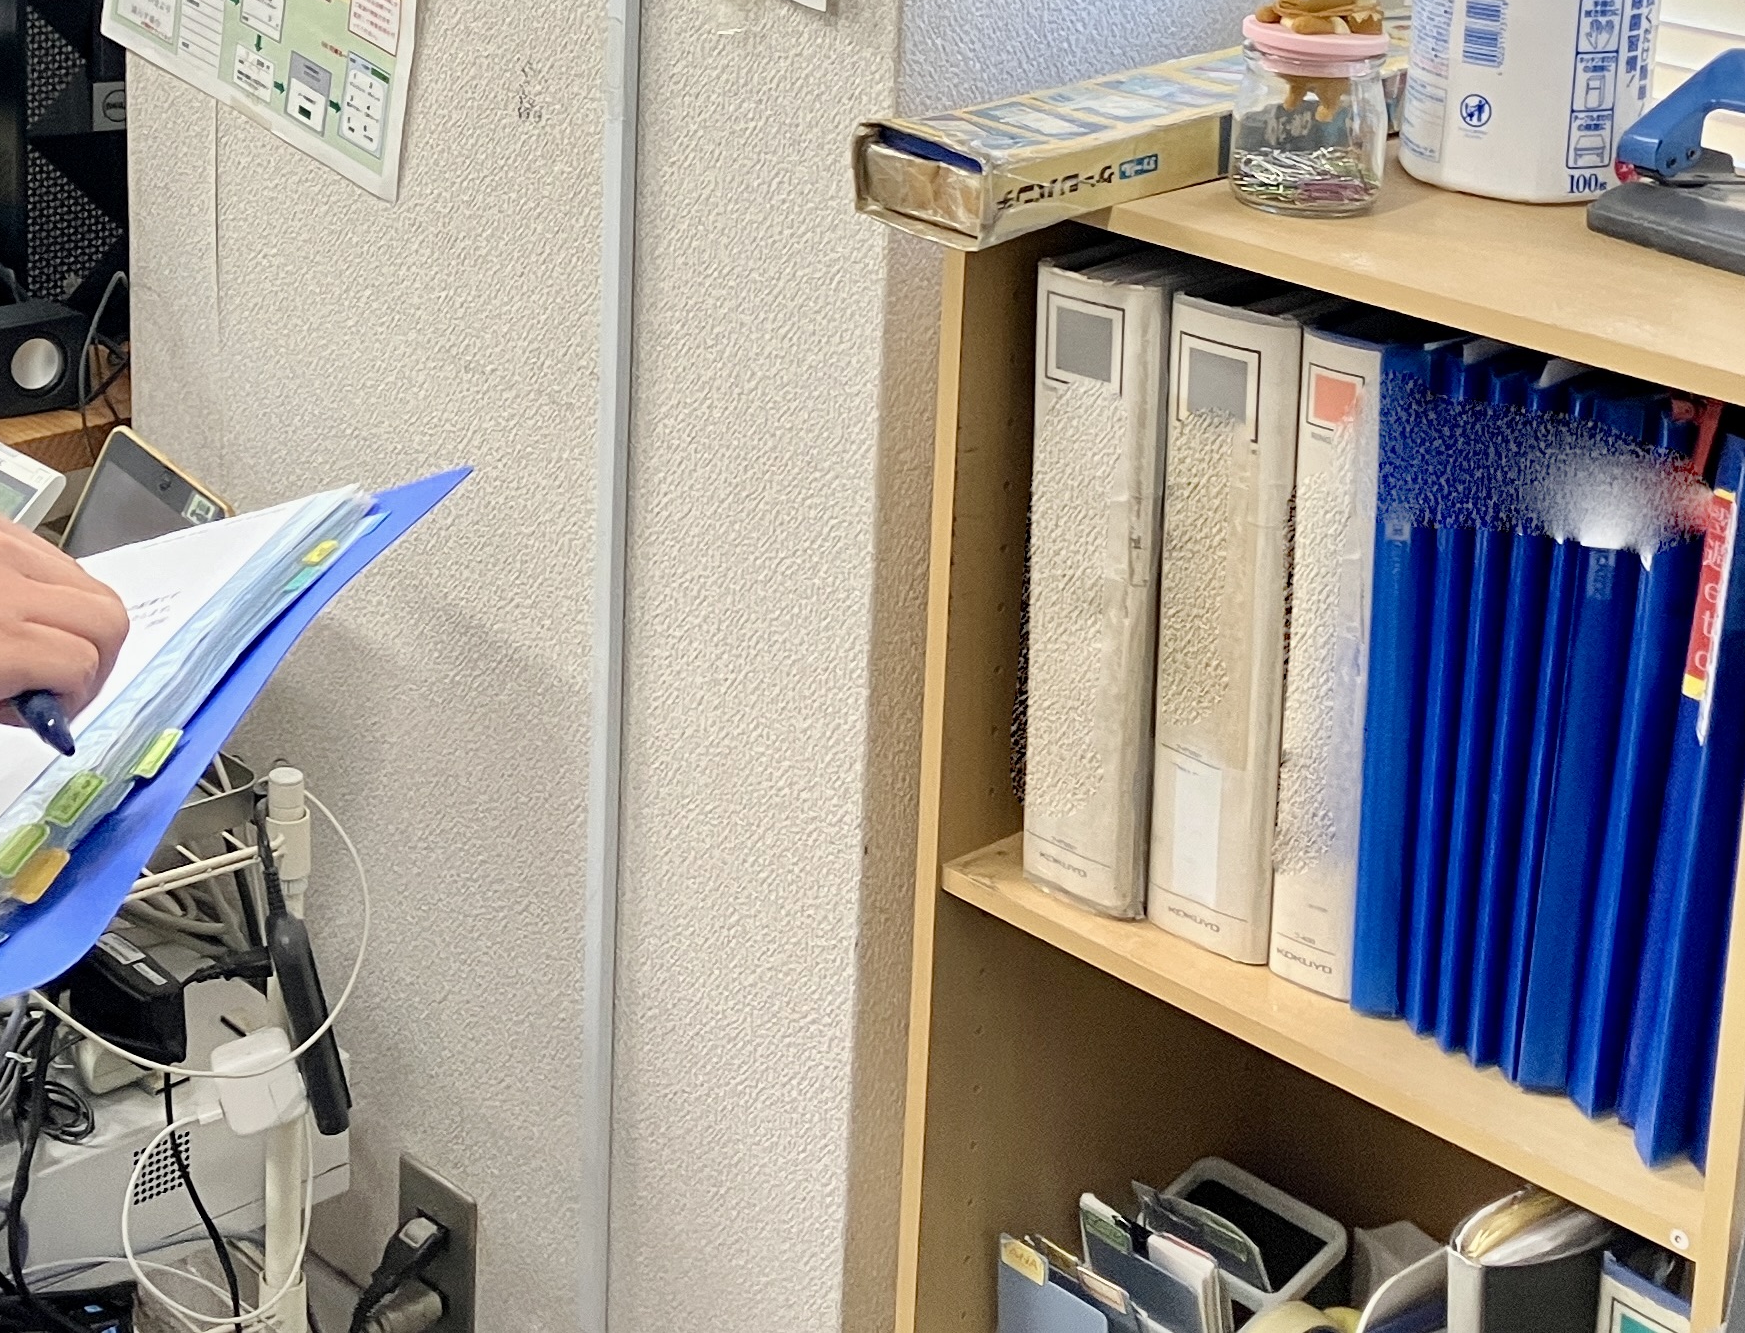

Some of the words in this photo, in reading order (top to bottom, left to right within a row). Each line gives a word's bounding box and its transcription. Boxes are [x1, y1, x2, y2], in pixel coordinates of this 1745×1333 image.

[1040, 851, 1088, 879] KOKUYO
[1168, 905, 1221, 934] KOKUYO
[1276, 946, 1333, 975] KOKUYO
